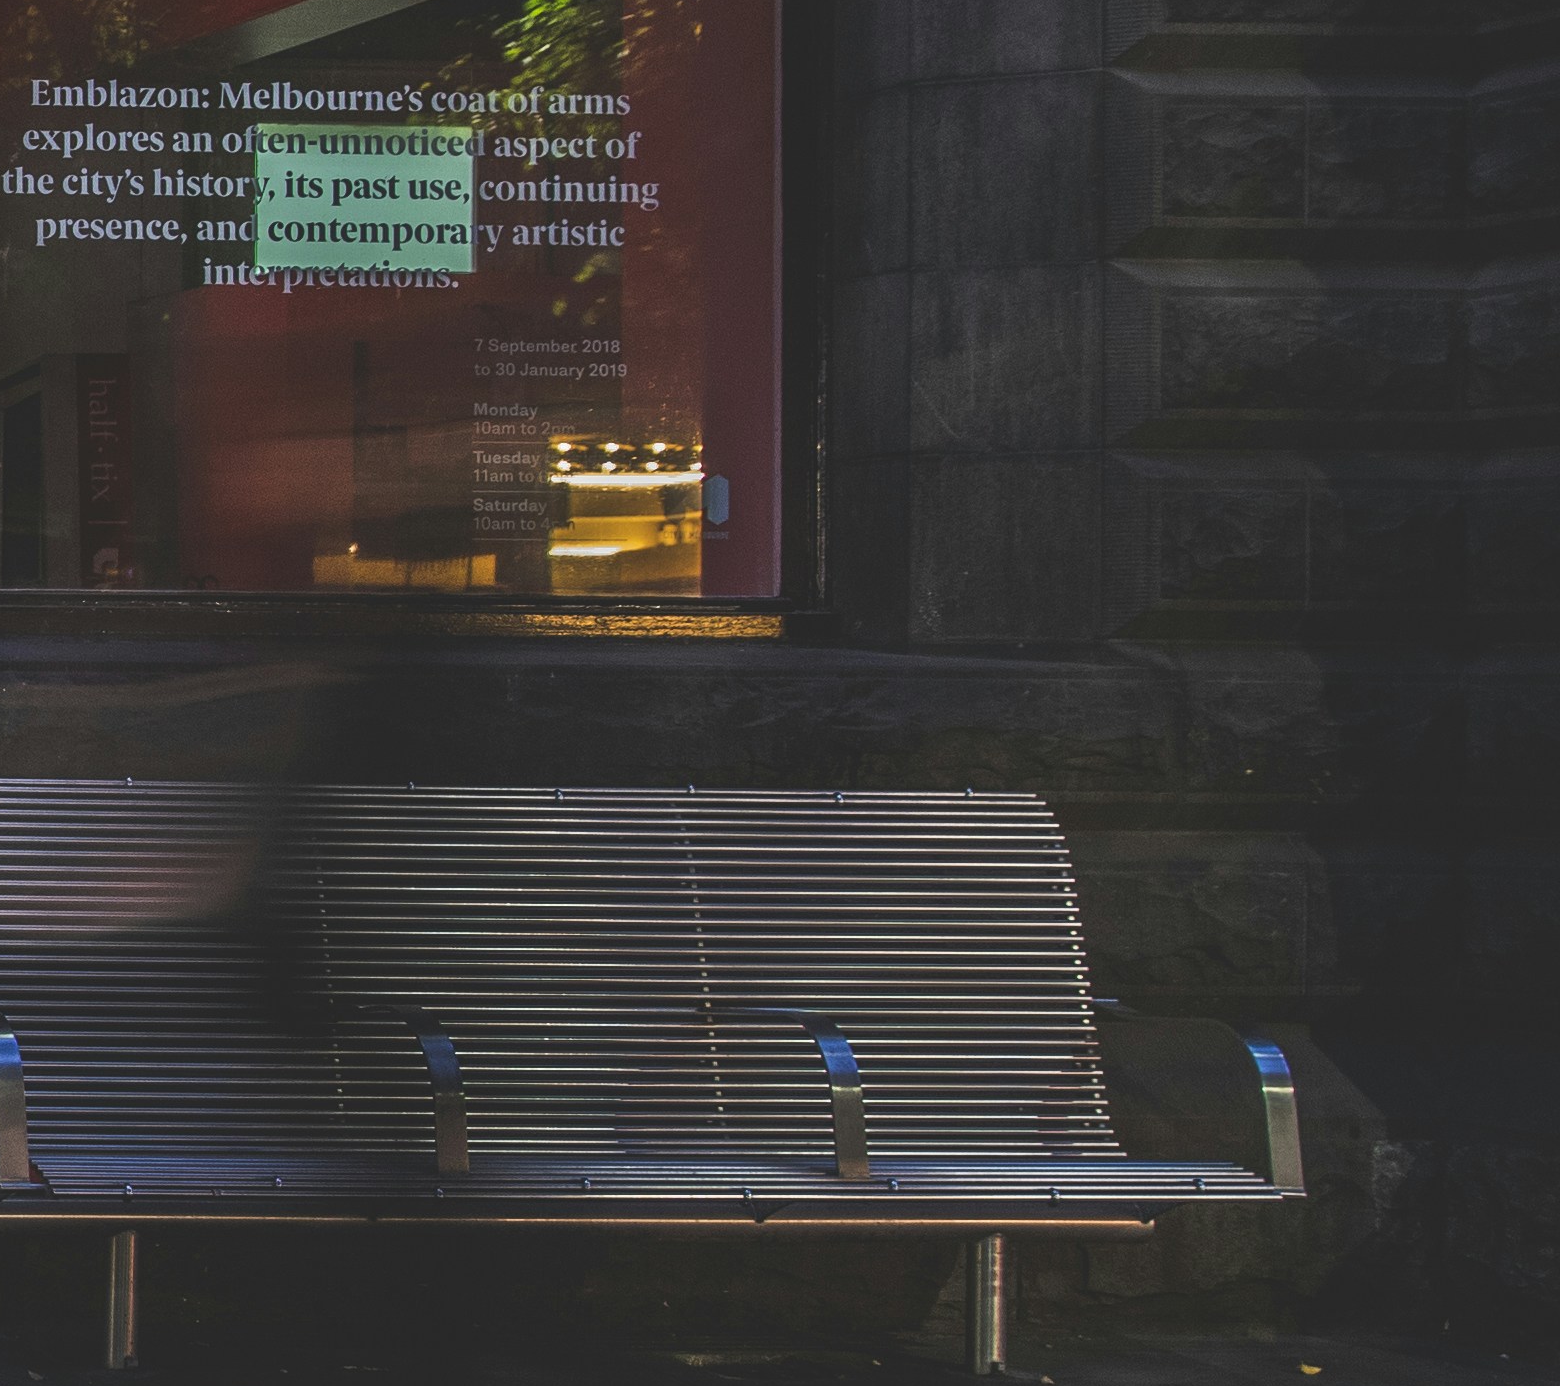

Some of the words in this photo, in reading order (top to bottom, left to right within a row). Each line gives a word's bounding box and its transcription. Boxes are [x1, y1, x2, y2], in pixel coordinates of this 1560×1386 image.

[31, 79, 209, 109] Emblazon:
[218, 81, 422, 111] Melbourne's
[431, 90, 500, 113] coat
[508, 86, 544, 114] of
[548, 93, 630, 116] arms
[22, 123, 164, 159] explores
[172, 131, 213, 153] an
[222, 124, 485, 157] often-unnoticed
[494, 134, 598, 165] aspect
[605, 131, 642, 159] of
[2, 167, 54, 195] the
[62, 168, 145, 203] city's
[153, 168, 276, 204] history,
[285, 170, 323, 198] its
[331, 175, 400, 206] past
[408, 178, 470, 204] use,
[479, 175, 660, 211] continuing
[35, 217, 187, 246] presence,
[197, 215, 257, 241] and
[268, 217, 504, 252] contemporary
[512, 219, 625, 246] artistic
[203, 257, 460, 294] interpretations.
[474, 339, 483, 352] 7
[488, 339, 578, 357] September
[582, 340, 620, 353] 2018
[474, 363, 491, 376] to
[496, 363, 515, 376] 30
[520, 363, 585, 380] January
[589, 364, 627, 377] 2019
[473, 403, 538, 420] Monday
[473, 421, 516, 435] 10am
[521, 422, 537, 435] to
[472, 451, 540, 467] Tuesday
[473, 469, 514, 482] 11am
[519, 470, 535, 483] to
[472, 498, 548, 515] Saturday
[473, 517, 518, 530] 10am
[520, 517, 536, 531] to
